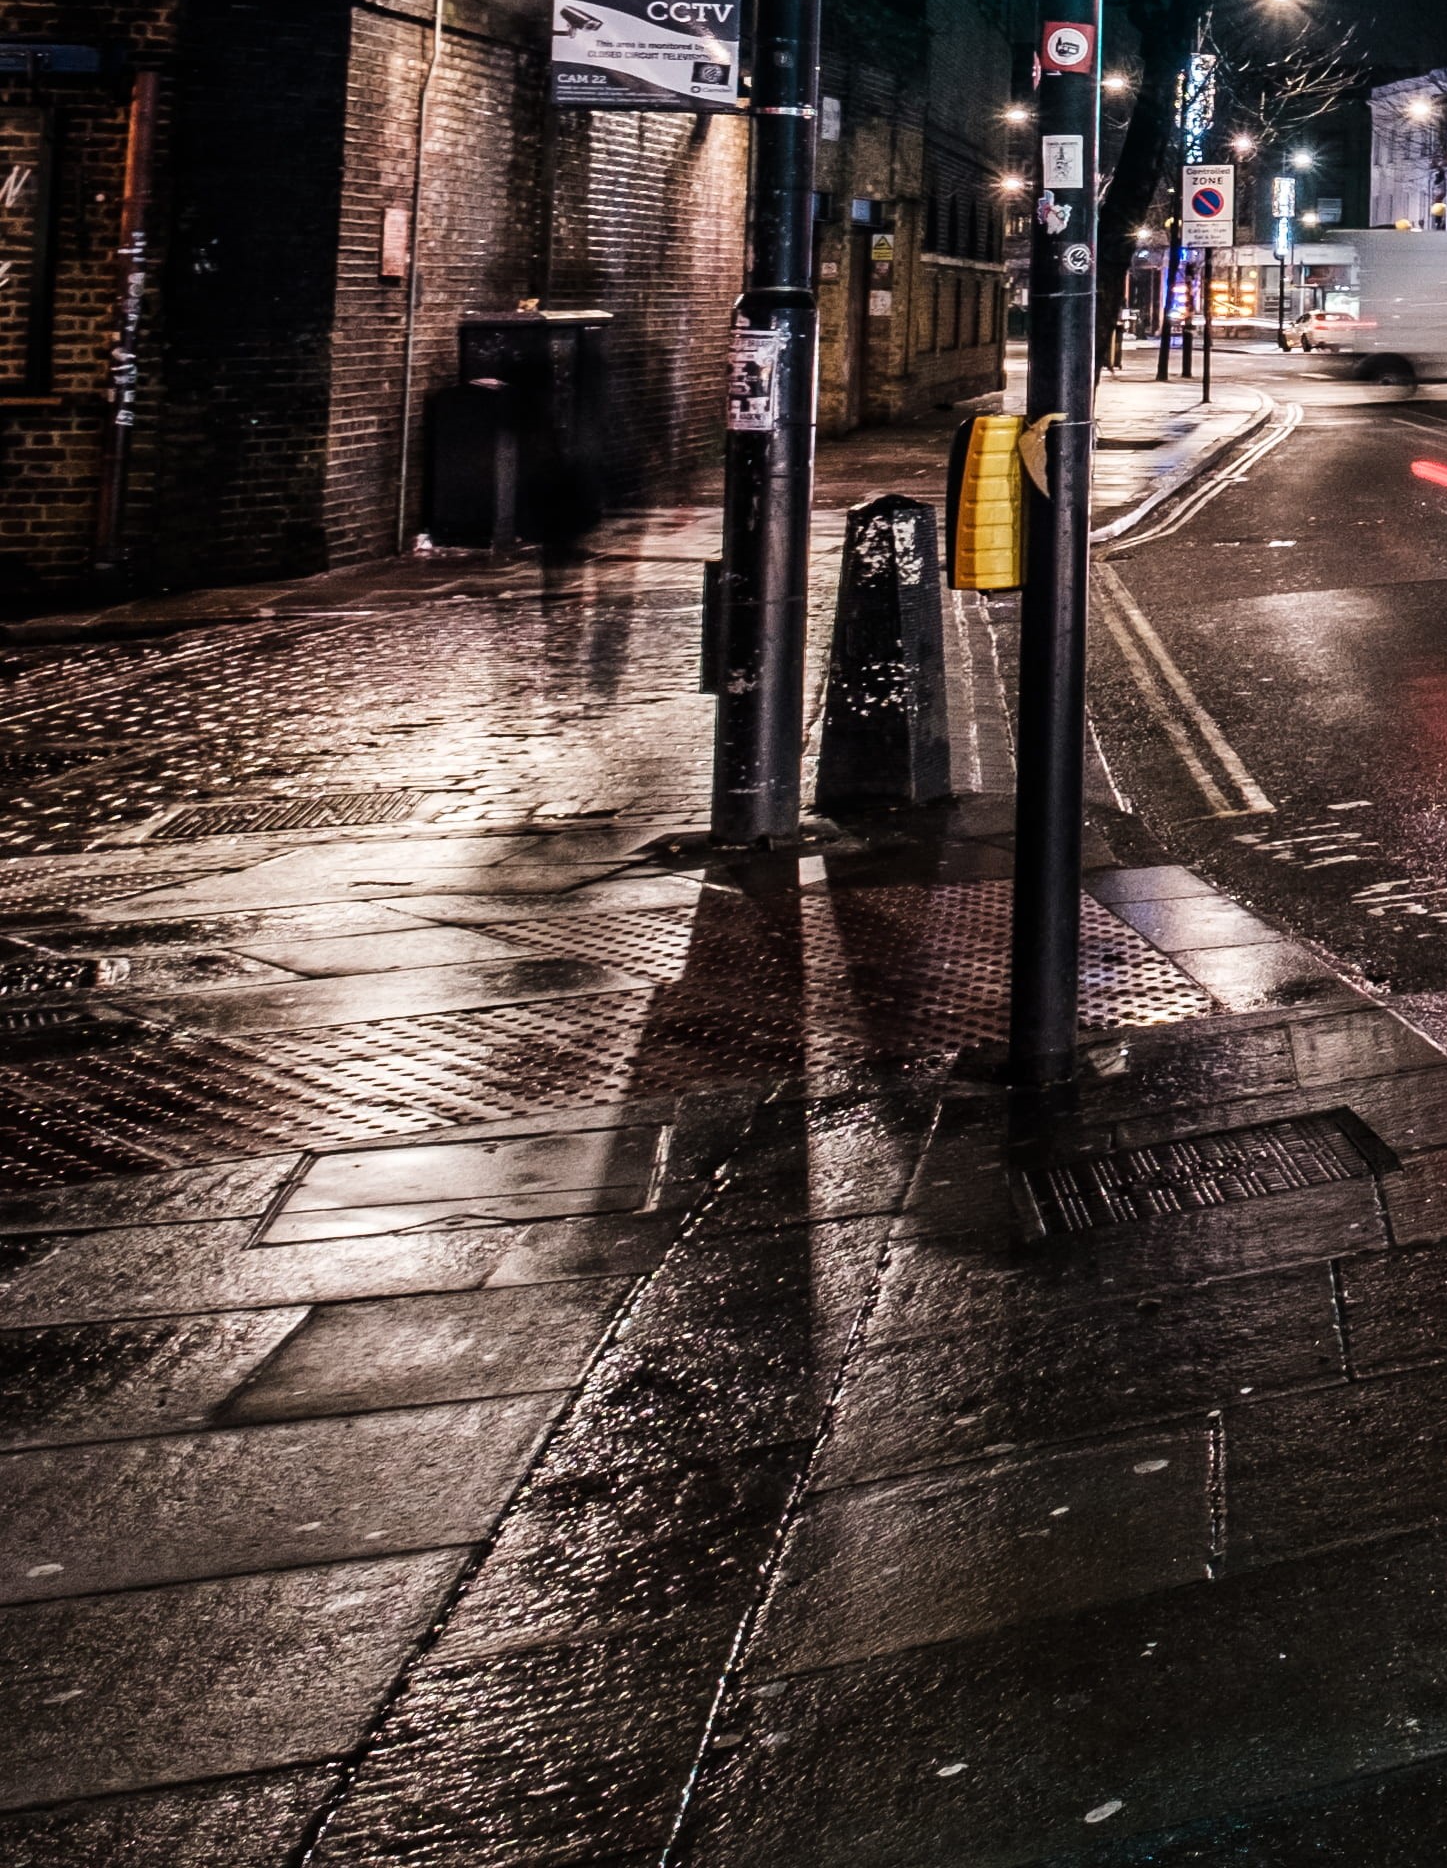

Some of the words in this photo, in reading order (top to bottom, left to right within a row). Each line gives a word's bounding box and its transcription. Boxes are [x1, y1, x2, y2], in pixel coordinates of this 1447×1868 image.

[647, 1, 735, 23] CCTV
[648, 41, 692, 51] monitored
[587, 50, 622, 59] CLOSED
[625, 51, 659, 60] CIRCUIT
[557, 73, 588, 84] CAM
[592, 75, 607, 84] 22
[1192, 177, 1224, 185] ZONE
